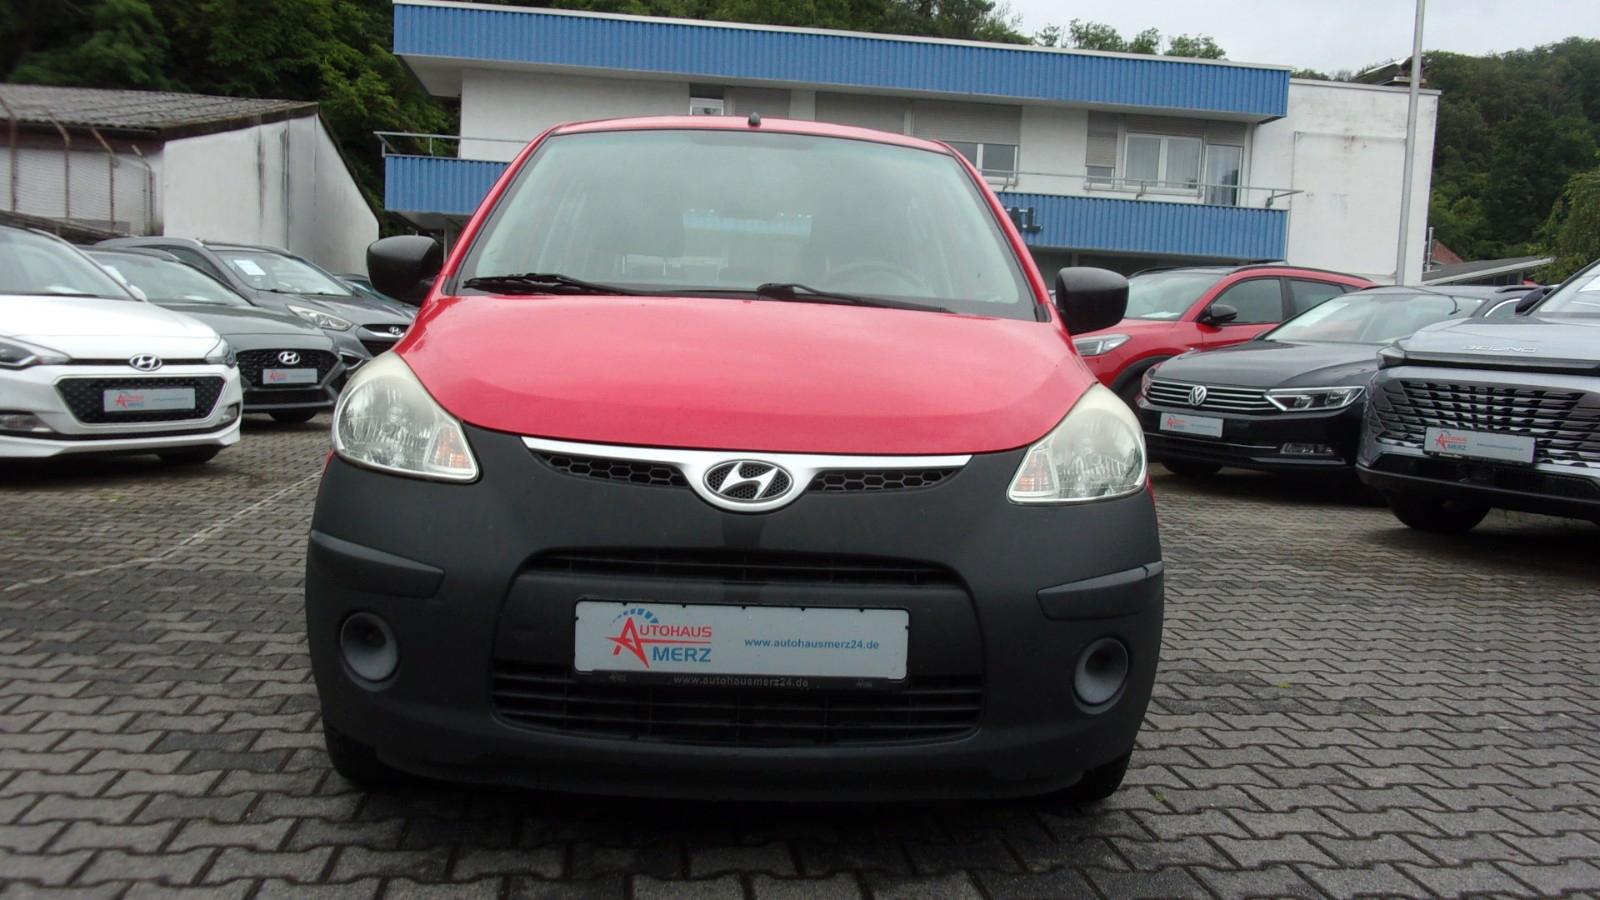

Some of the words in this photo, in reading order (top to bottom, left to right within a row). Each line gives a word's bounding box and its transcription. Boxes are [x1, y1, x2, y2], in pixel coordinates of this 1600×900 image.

[604, 616, 713, 667] AUTOHAUS
[743, 638, 880, 650] www.autohausmerz24.de
[652, 646, 712, 663] MERZ
